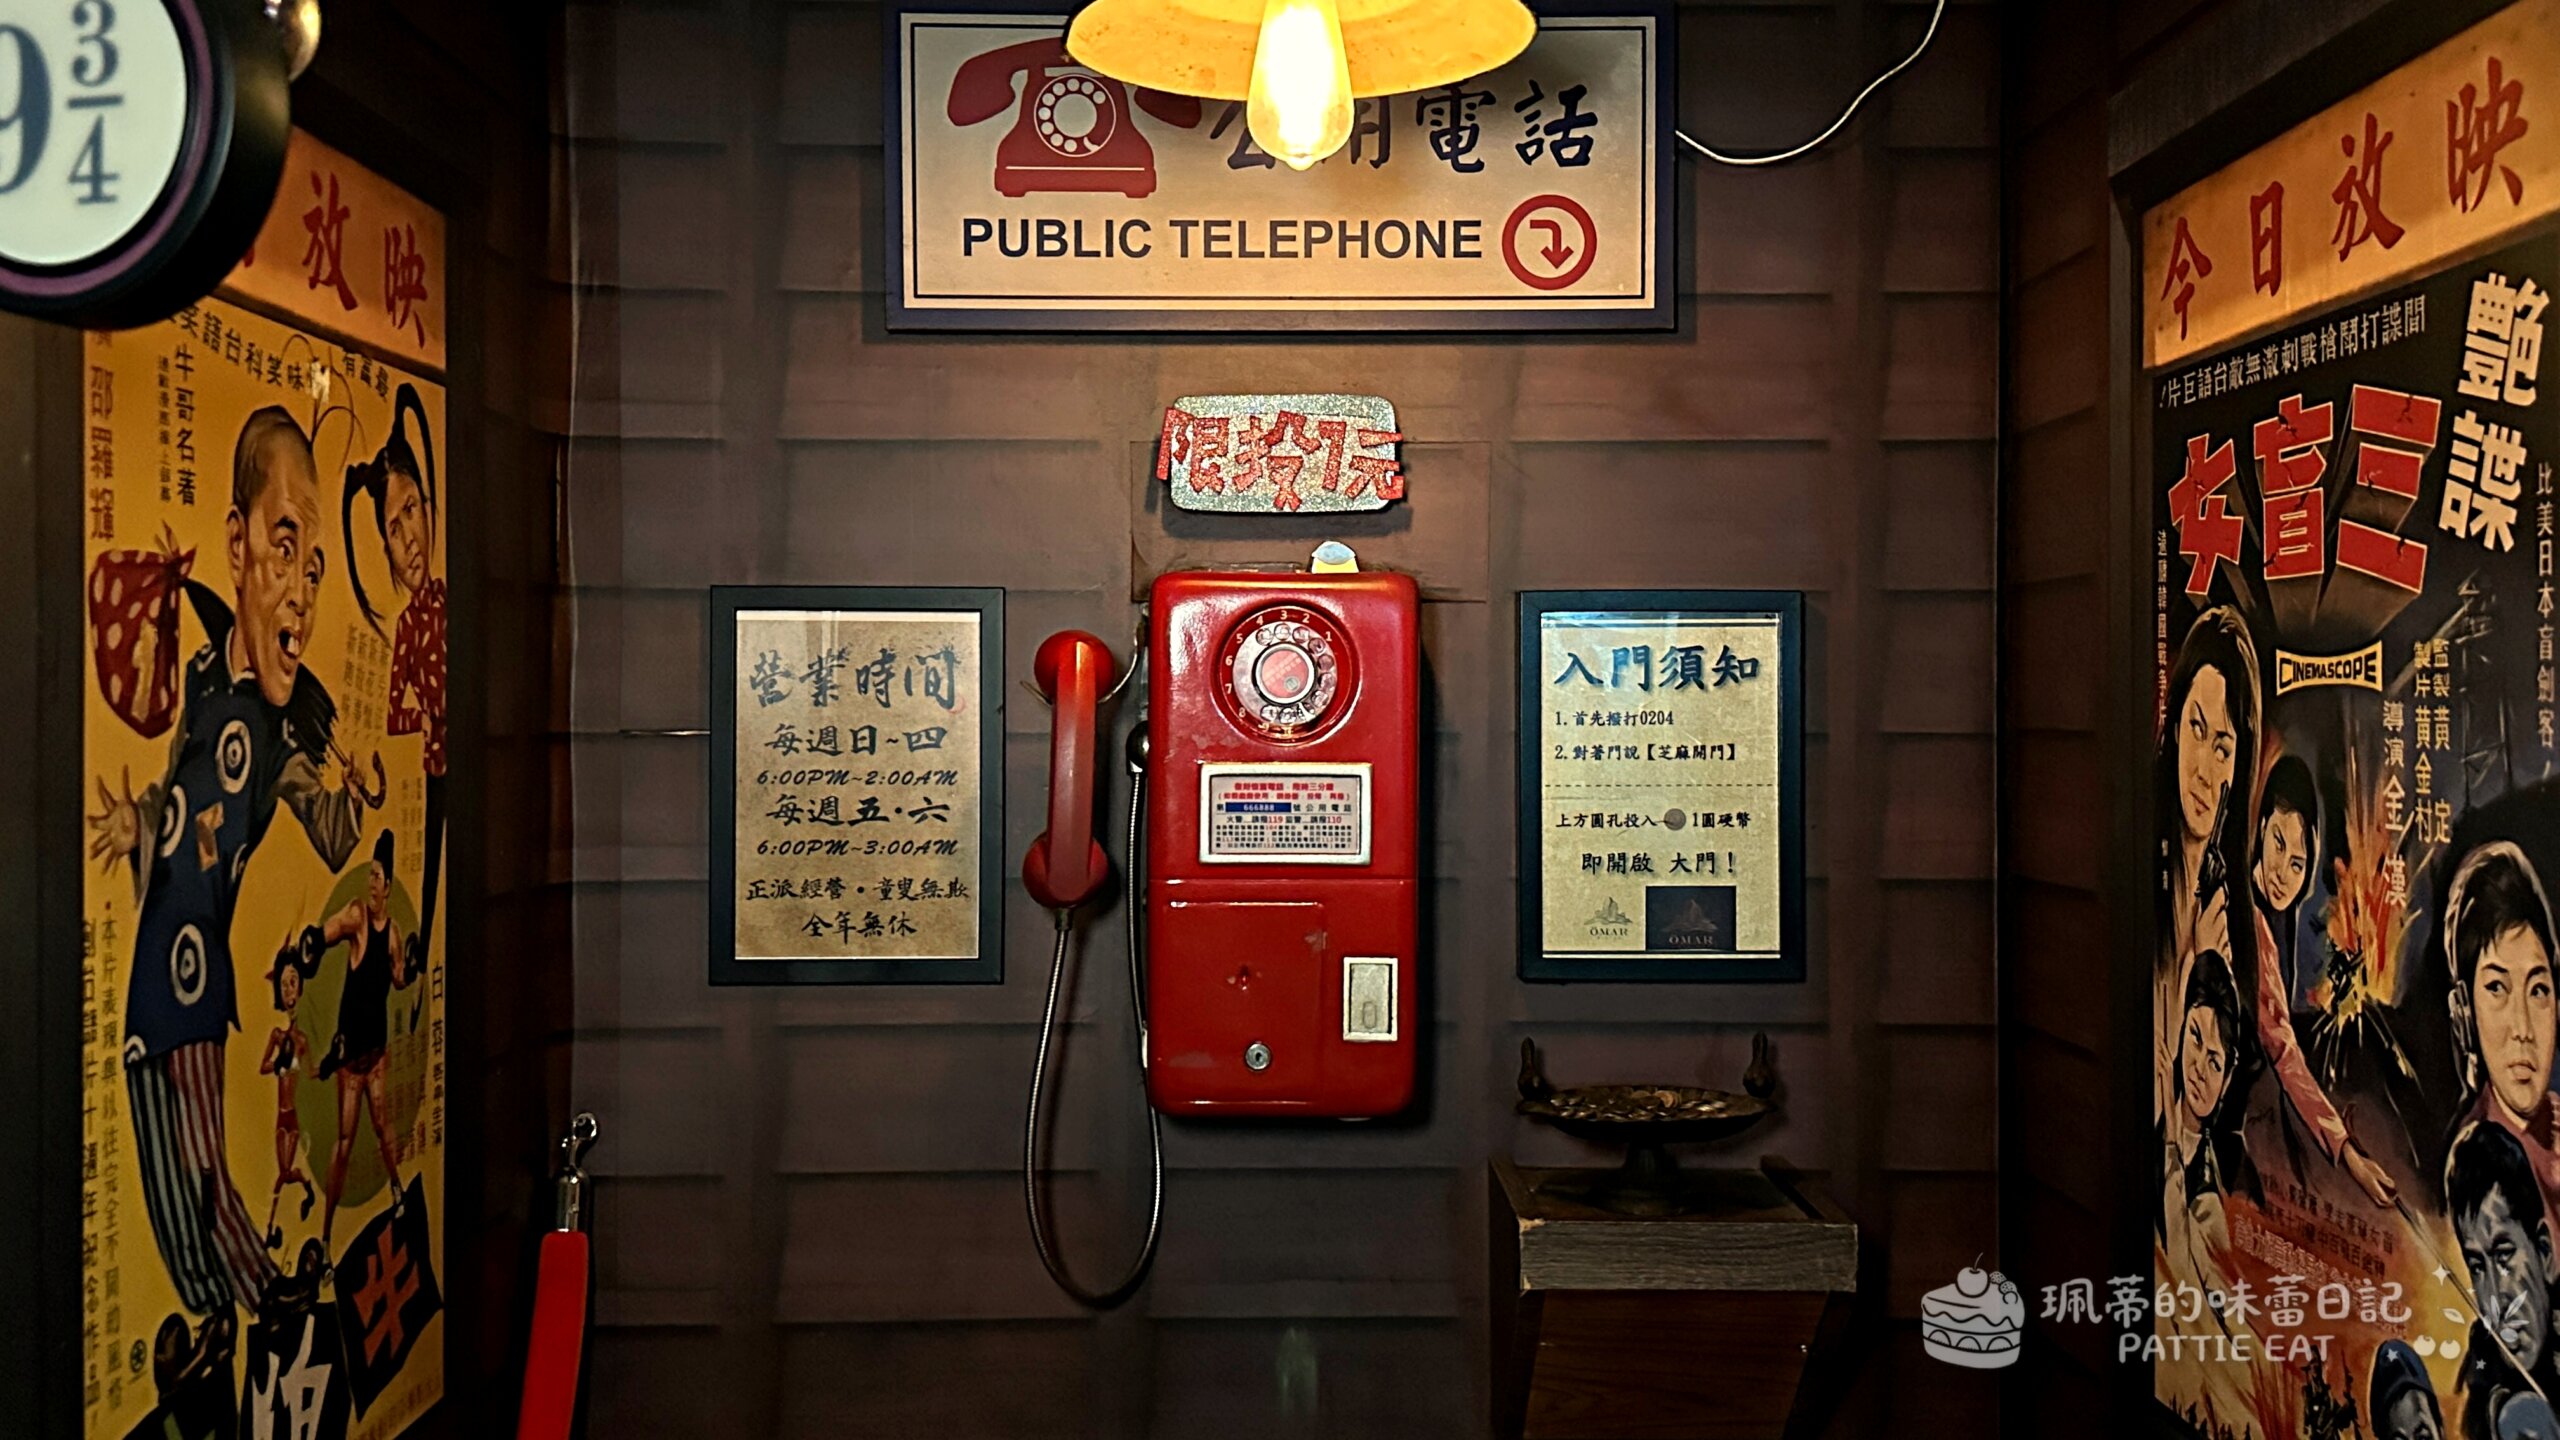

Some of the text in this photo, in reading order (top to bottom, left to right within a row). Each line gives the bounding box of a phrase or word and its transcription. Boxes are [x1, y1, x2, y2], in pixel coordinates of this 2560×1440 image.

[1210, 79, 1599, 174] 公用電話
[2160, 56, 2530, 341] 今日放映
[962, 218, 1483, 259] PUBLIC TELEPHONE
[749, 645, 957, 710] 營業時間
[1553, 643, 1762, 692] 入門須知
[2279, 651, 2377, 689] CINEMASCOPE
[1572, 710, 1675, 728] 首先撥打0204
[1581, 851, 1655, 876] 即開啟
[800, 911, 919, 946] 全年無休
